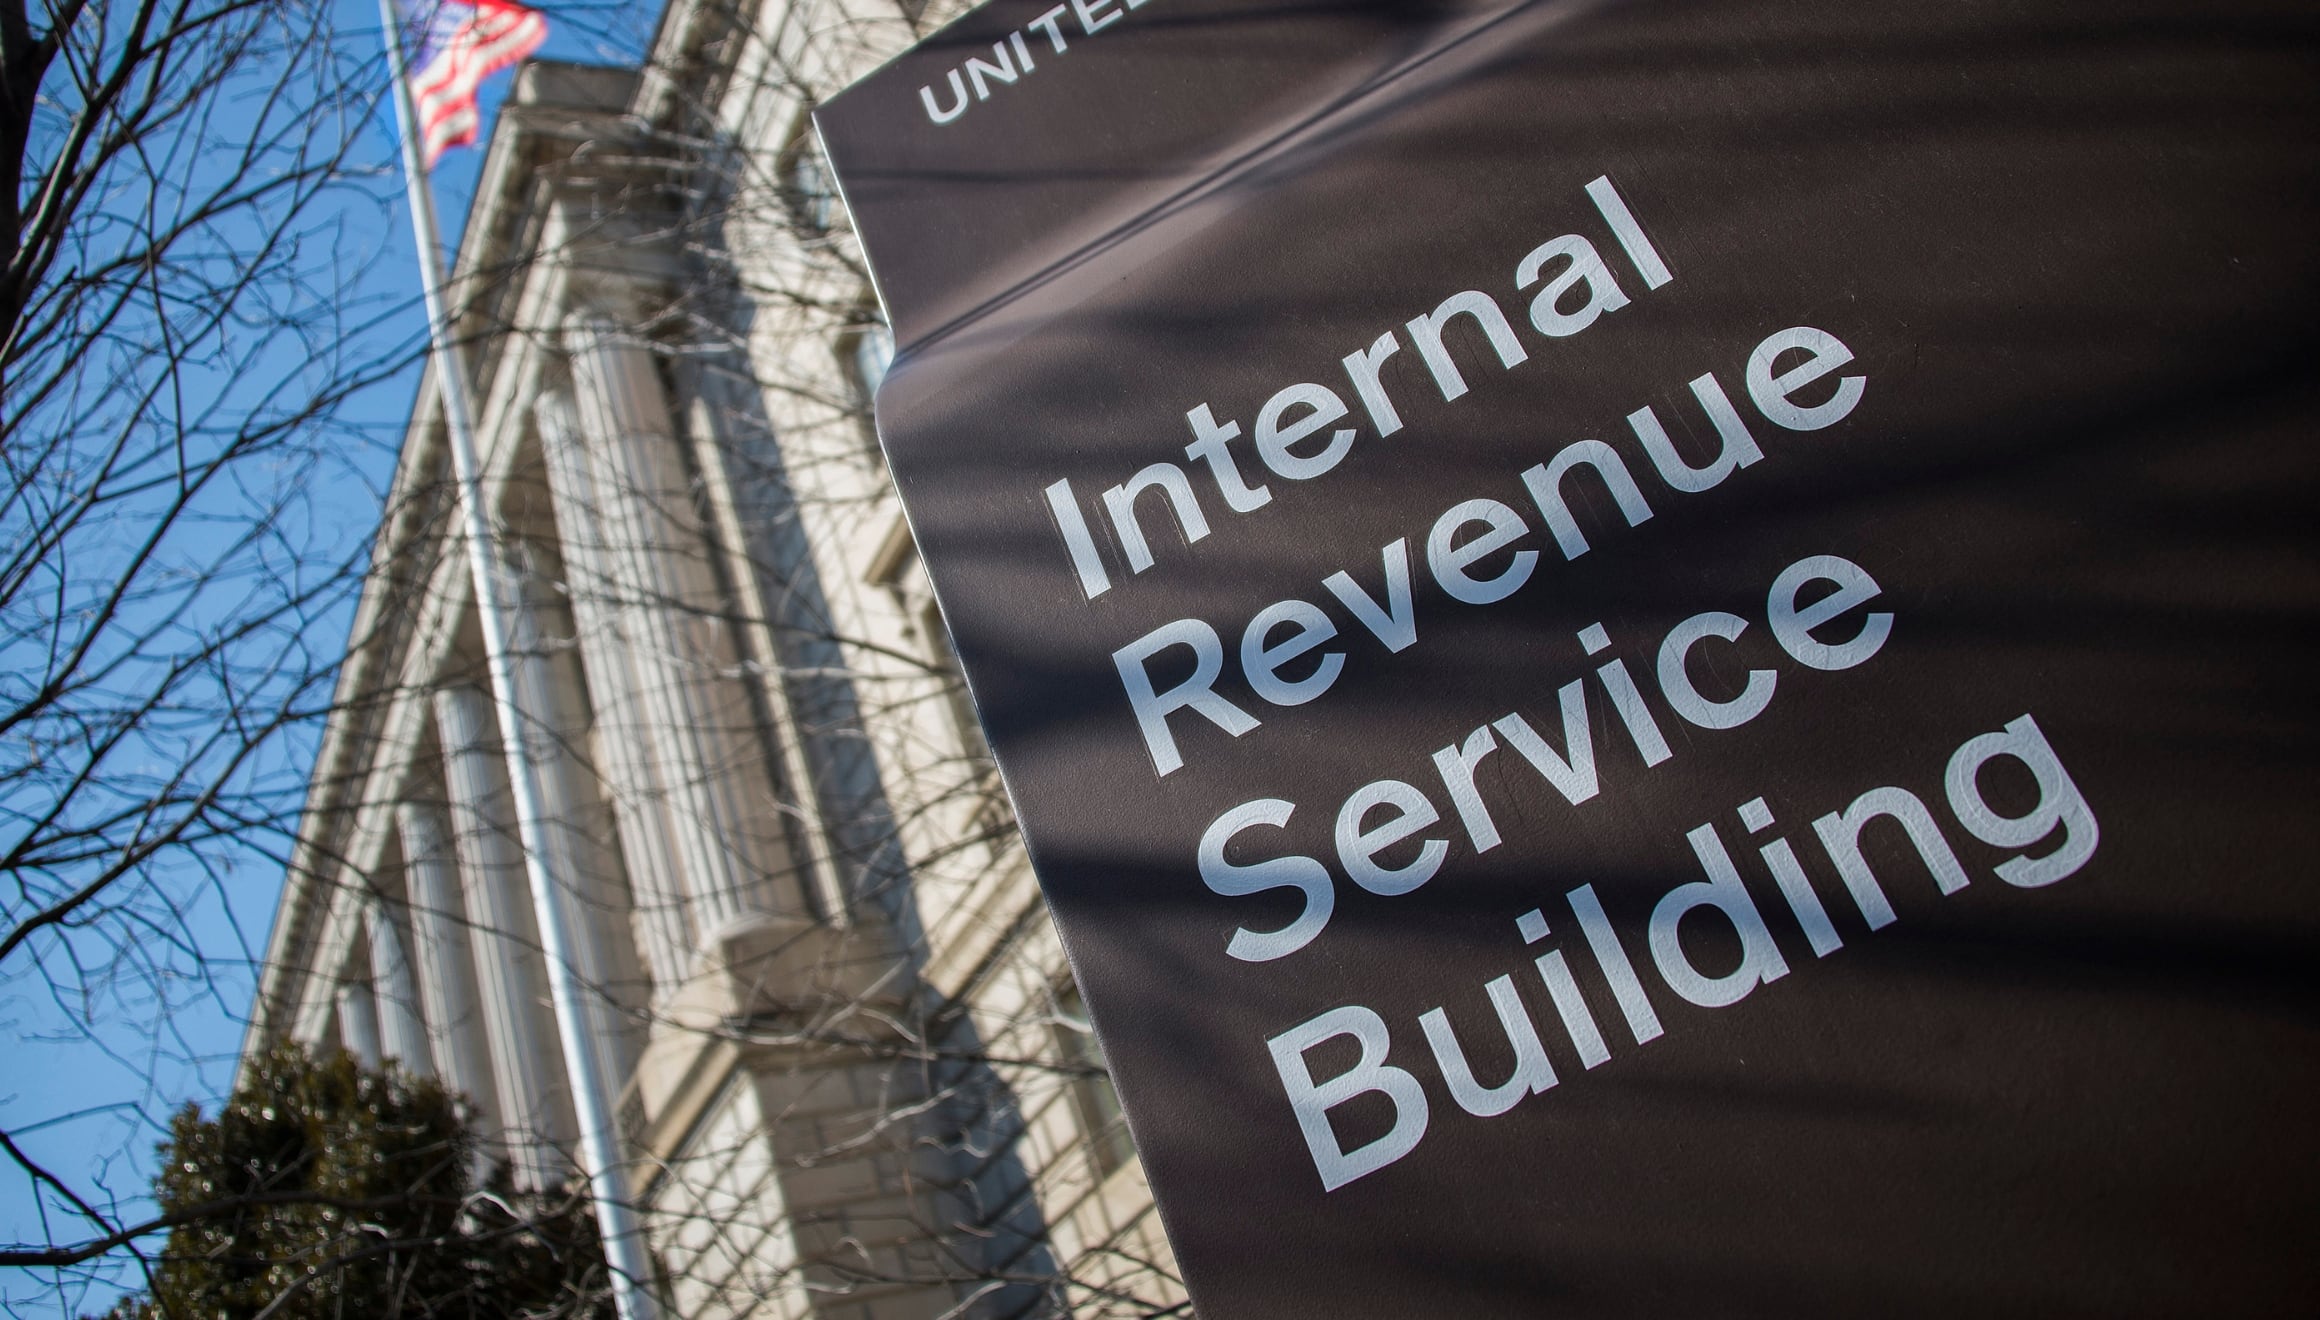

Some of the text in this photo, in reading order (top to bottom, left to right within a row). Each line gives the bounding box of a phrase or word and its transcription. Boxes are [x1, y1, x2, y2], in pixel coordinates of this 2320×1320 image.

[918, 0, 1151, 126] UNITE
[1043, 175, 1673, 600] Internal
[1111, 326, 1867, 777] Revenue
[1197, 554, 1894, 963] Service
[1266, 713, 2100, 1192] Building
